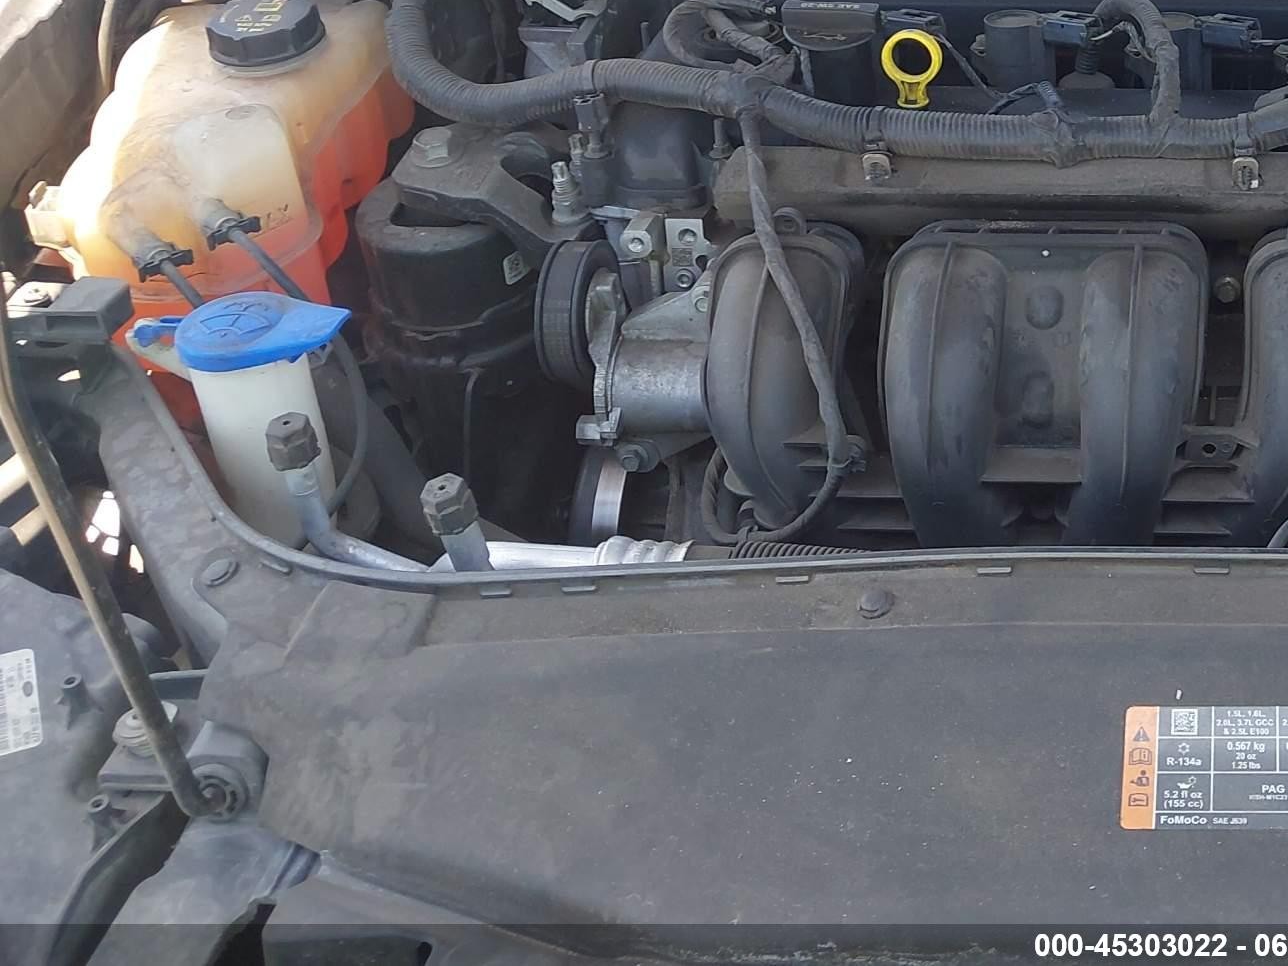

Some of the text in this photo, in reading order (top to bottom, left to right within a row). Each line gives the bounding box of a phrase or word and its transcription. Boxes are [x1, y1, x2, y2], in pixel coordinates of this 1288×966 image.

[1227, 742, 1266, 753] 0.567 kg
[1235, 752, 1246, 760] 20
[1166, 757, 1202, 766] R-134a
[1231, 761, 1261, 769] 1.25 lbs
[1261, 784, 1286, 794] PAG
[1163, 790, 1180, 799] 5.2
[1180, 790, 1188, 799] fl
[1163, 799, 1204, 809] (155 cc)
[1160, 815, 1208, 825] FoMoCo
[1212, 817, 1229, 825] SAE
